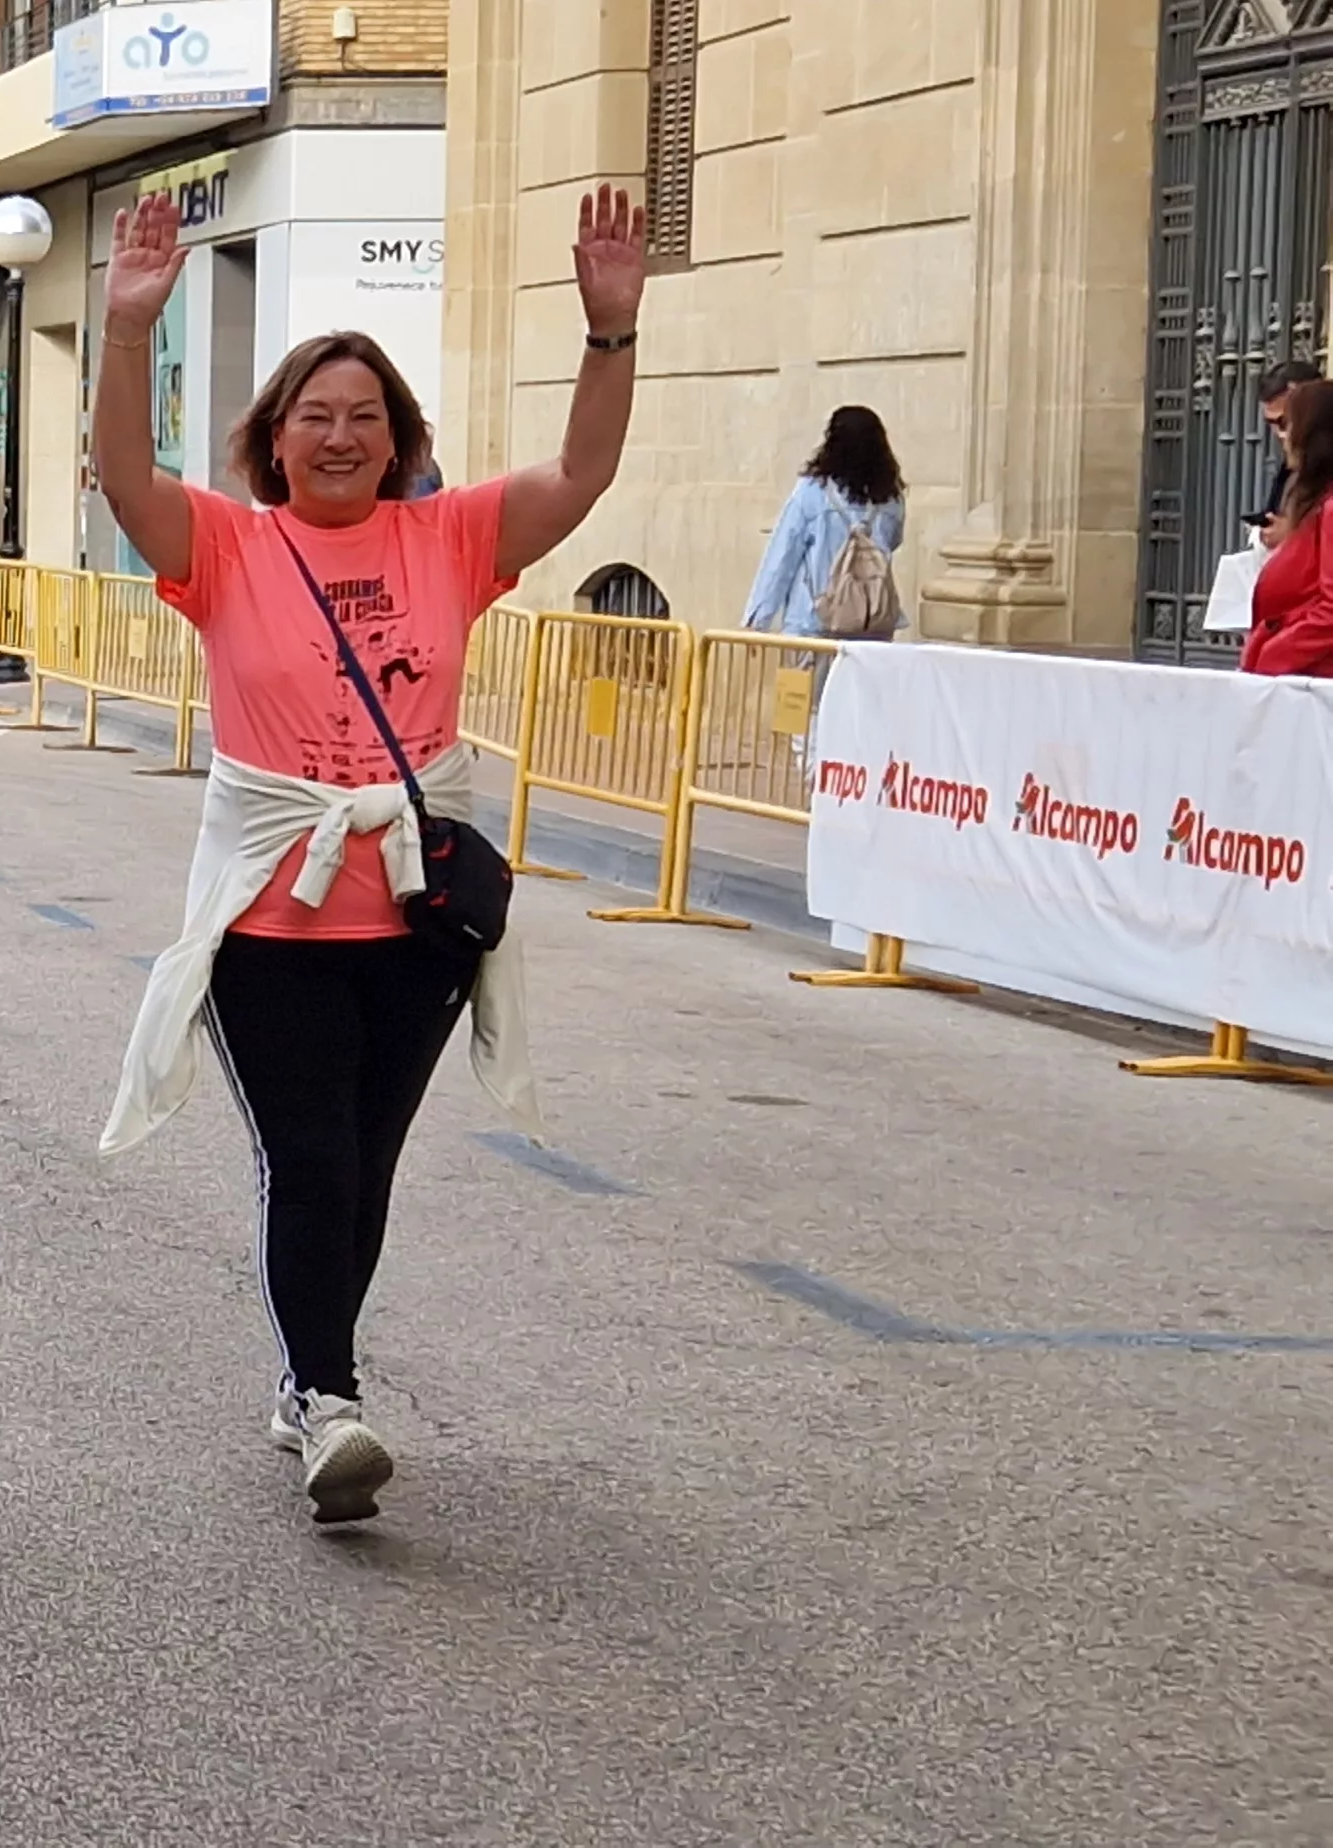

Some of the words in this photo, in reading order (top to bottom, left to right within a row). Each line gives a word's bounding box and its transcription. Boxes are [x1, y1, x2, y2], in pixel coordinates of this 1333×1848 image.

[876, 750, 989, 832] Alcampo
[1012, 771, 1139, 860] Alcampo
[1163, 797, 1305, 892] Alcampo
